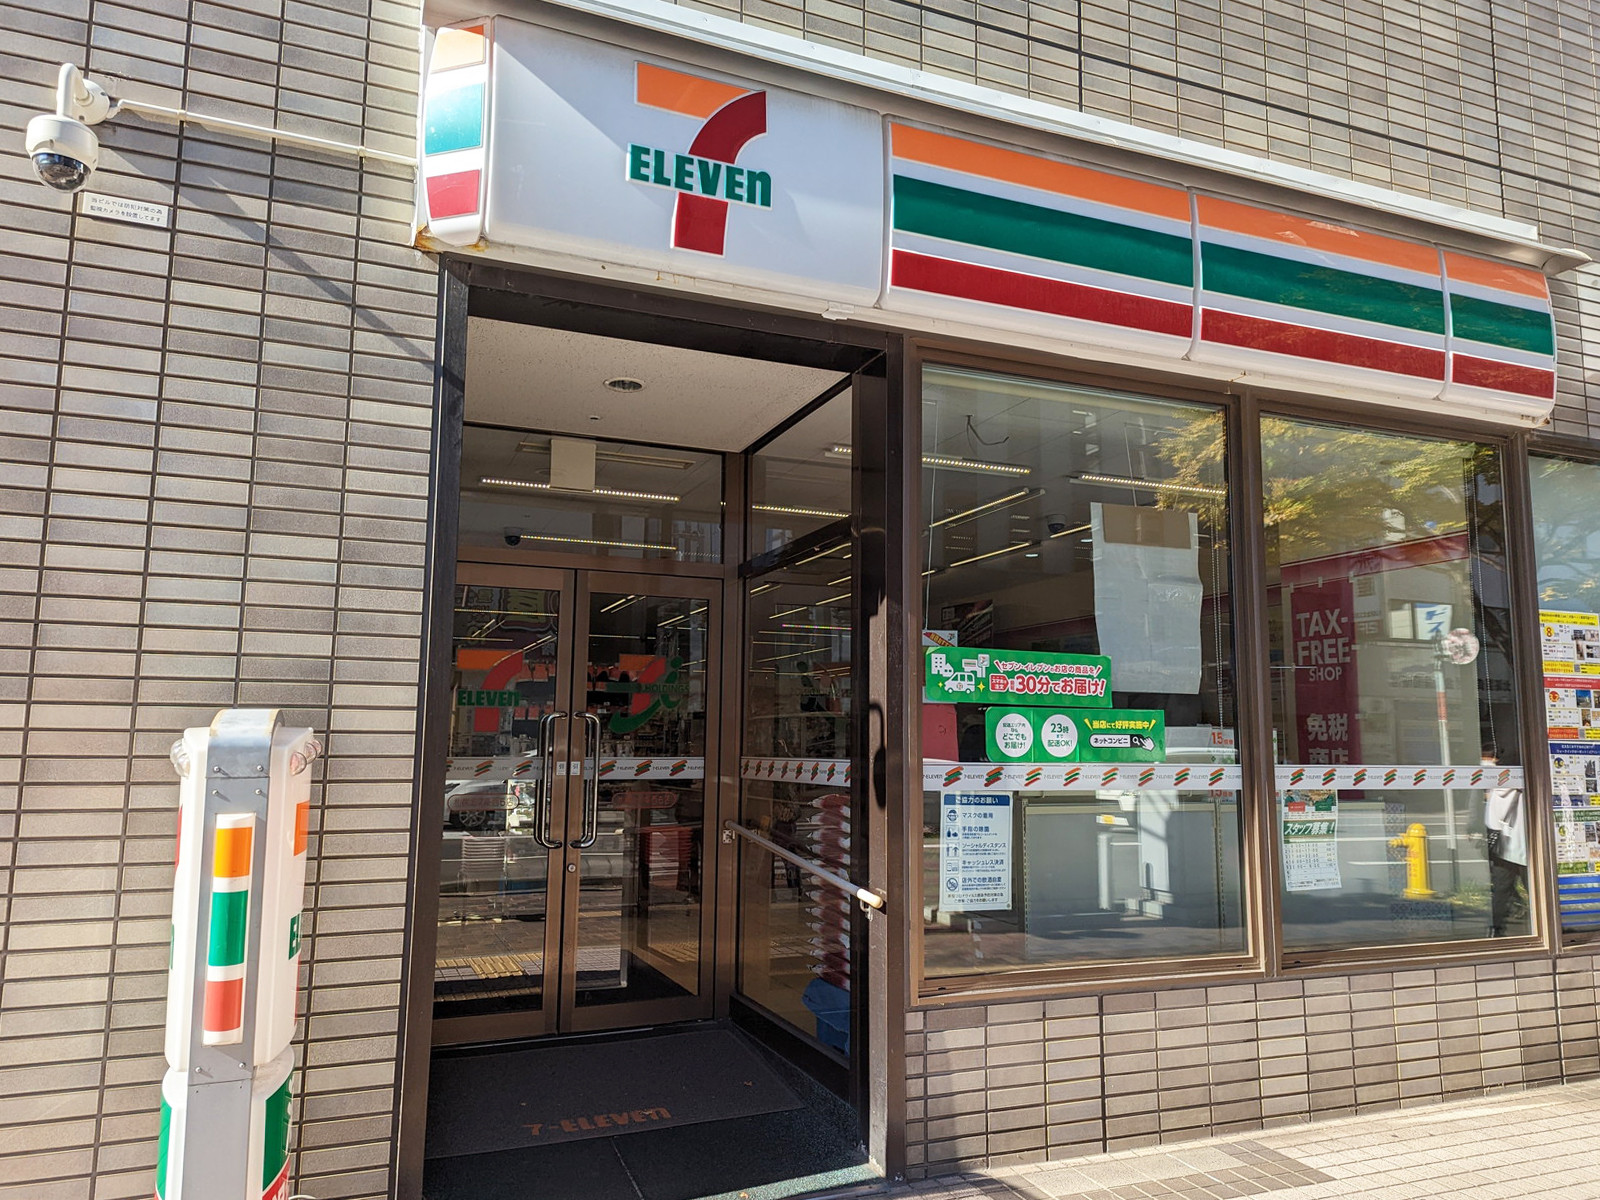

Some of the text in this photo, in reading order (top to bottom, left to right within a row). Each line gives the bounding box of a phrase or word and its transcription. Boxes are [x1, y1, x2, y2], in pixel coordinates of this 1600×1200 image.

[636, 62, 767, 256] 7
[1296, 608, 1348, 638] TAX-
[1297, 637, 1350, 664] FREE
[1309, 666, 1342, 682] SHOP
[1050, 723, 1069, 733] 23時
[1307, 713, 1348, 741] 免税
[1002, 733, 1026, 741] どこでも
[1094, 737, 1128, 745] ネットコンビニ
[956, 796, 999, 804] ご協力のお願い
